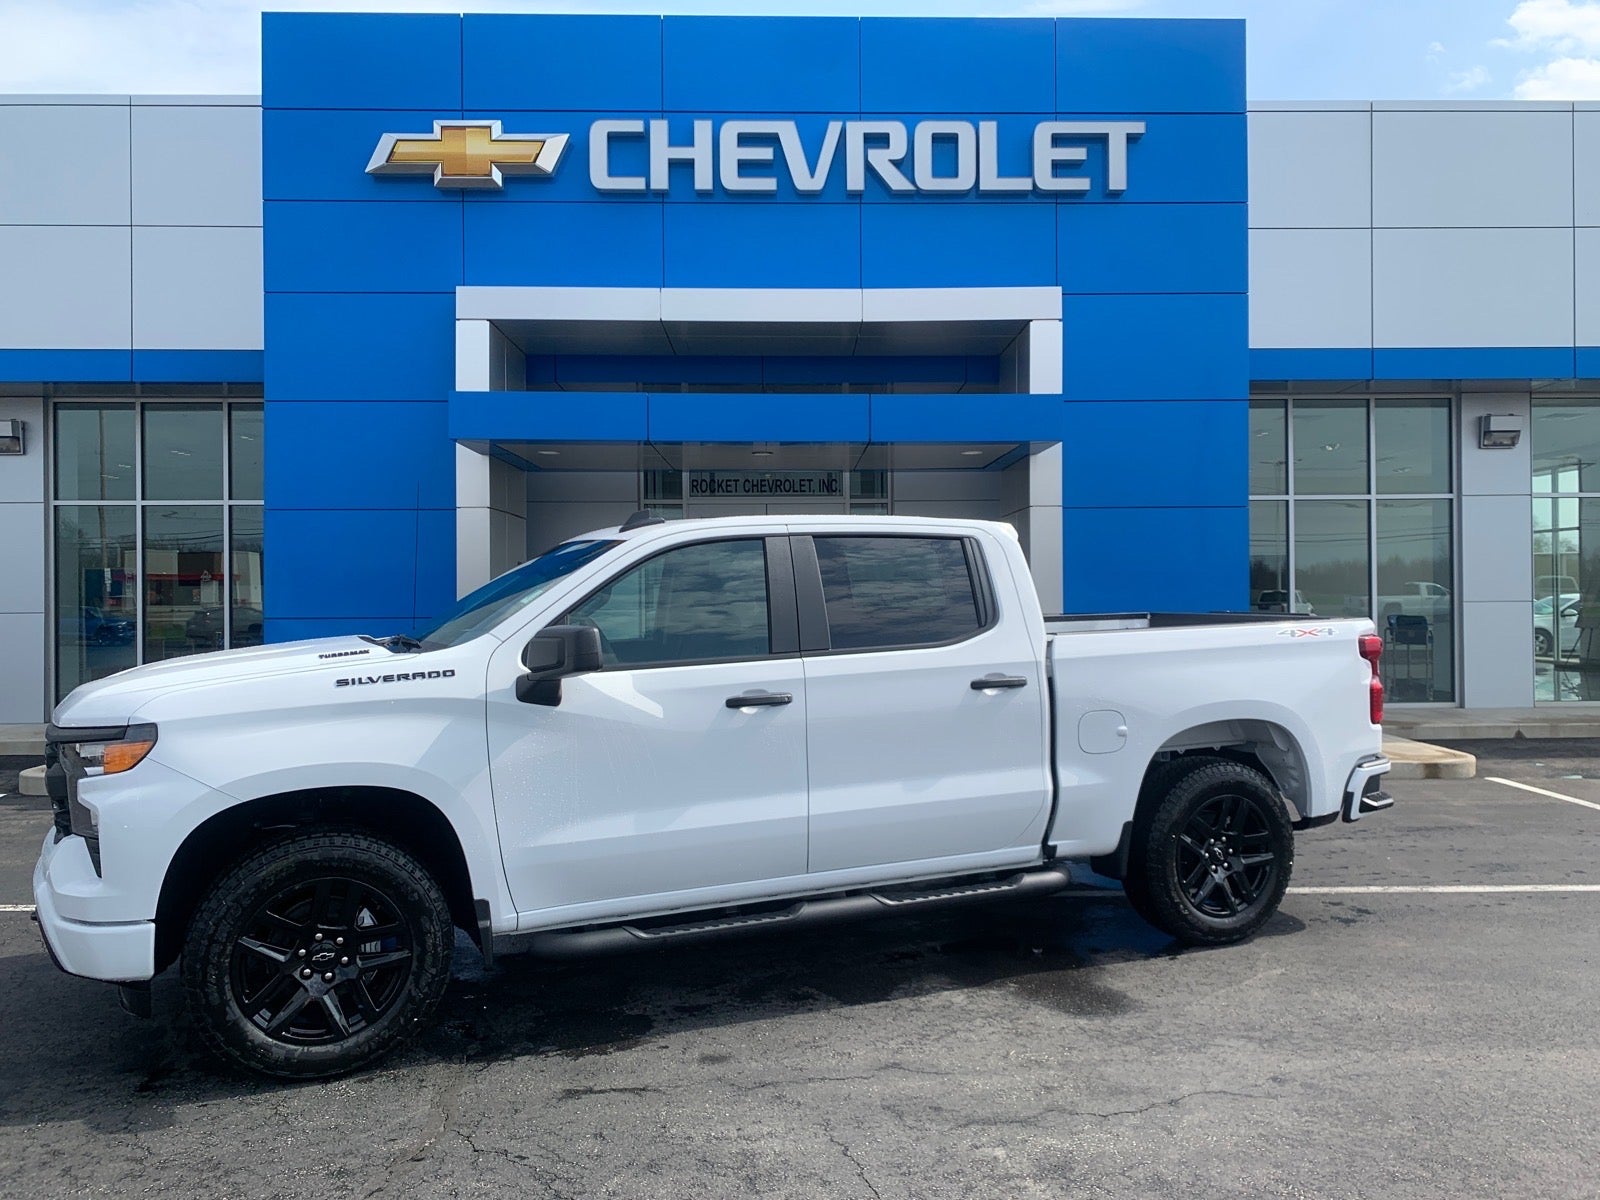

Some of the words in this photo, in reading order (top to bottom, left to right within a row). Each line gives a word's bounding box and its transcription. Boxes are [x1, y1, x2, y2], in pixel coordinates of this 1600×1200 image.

[588, 119, 1147, 194] CHEVROLET
[691, 478, 740, 493] ROCKET
[818, 478, 841, 493] INC.
[335, 669, 455, 687] SILVERADO
